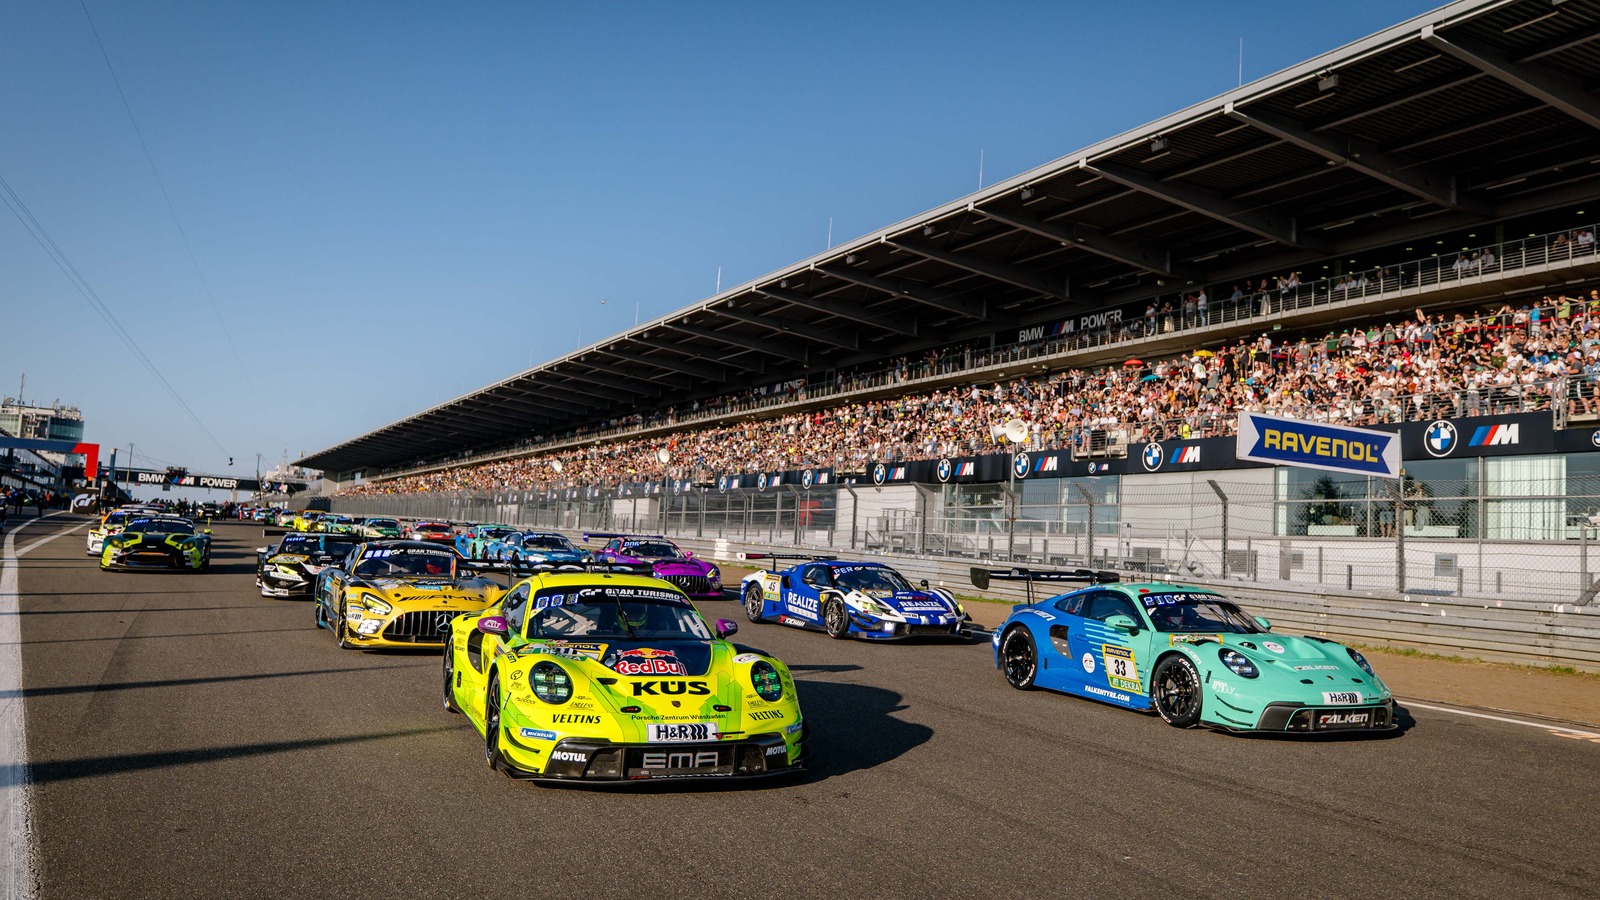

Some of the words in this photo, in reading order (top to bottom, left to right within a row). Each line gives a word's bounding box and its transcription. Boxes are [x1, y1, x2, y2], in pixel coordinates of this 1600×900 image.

[1018, 325, 1044, 342] BMW
[1489, 423, 1519, 446] M
[1264, 428, 1379, 463] RAVENOL
[1182, 445, 1201, 463] M
[1044, 456, 1058, 471] M
[138, 472, 165, 483] BMW
[181, 476, 195, 485] M
[200, 477, 237, 488] POWER
[833, 566, 853, 575] PER
[605, 588, 634, 596] GRAN
[637, 589, 680, 600] TURISMO
[768, 581, 776, 592] 45
[788, 591, 819, 612] REALIZE
[1106, 647, 1130, 657] RAVENOL
[614, 659, 655, 675] Red
[653, 659, 688, 676] Bull
[1114, 658, 1127, 677] 33
[630, 681, 711, 696] KÜS
[1120, 679, 1140, 692] DEKRA
[1085, 685, 1130, 702] FALKENTYRE.COM
[1329, 692, 1348, 703] H&R
[552, 713, 602, 724] VELTINS
[748, 709, 784, 721] VELTINS
[1319, 713, 1369, 724] FALKEN
[656, 725, 690, 739] H&R
[552, 750, 587, 762] MOTUL
[642, 751, 719, 769] EMA
